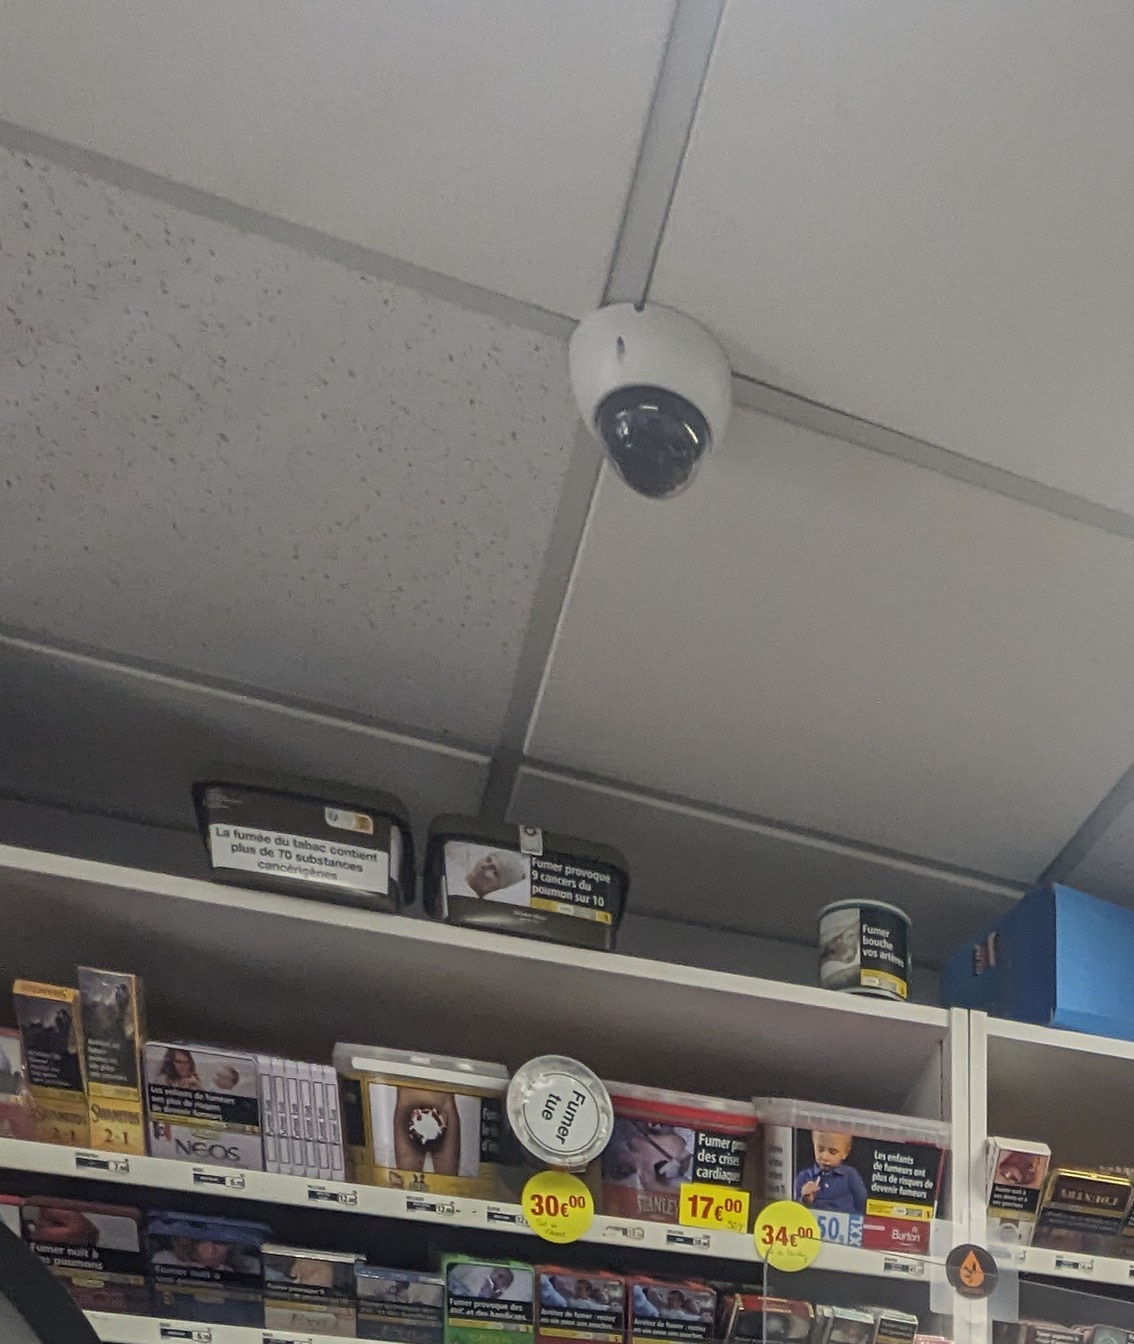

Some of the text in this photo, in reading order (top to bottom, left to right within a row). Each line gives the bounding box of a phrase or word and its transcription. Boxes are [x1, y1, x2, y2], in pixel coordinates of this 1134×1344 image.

[232, 843, 257, 858] plus
[261, 848, 275, 859] de
[279, 847, 293, 860] 70
[275, 837, 289, 847] du
[294, 838, 326, 854] tabac
[579, 879, 592, 892] du
[575, 893, 590, 905] sur
[593, 894, 604, 907] 10
[863, 924, 890, 938] Fumer
[541, 1092, 562, 1121] tue
[555, 1089, 586, 1146] Fumer
[699, 1133, 730, 1154] Fumer
[697, 1152, 716, 1164] des
[874, 1150, 886, 1162] Les
[873, 1161, 883, 1171] de
